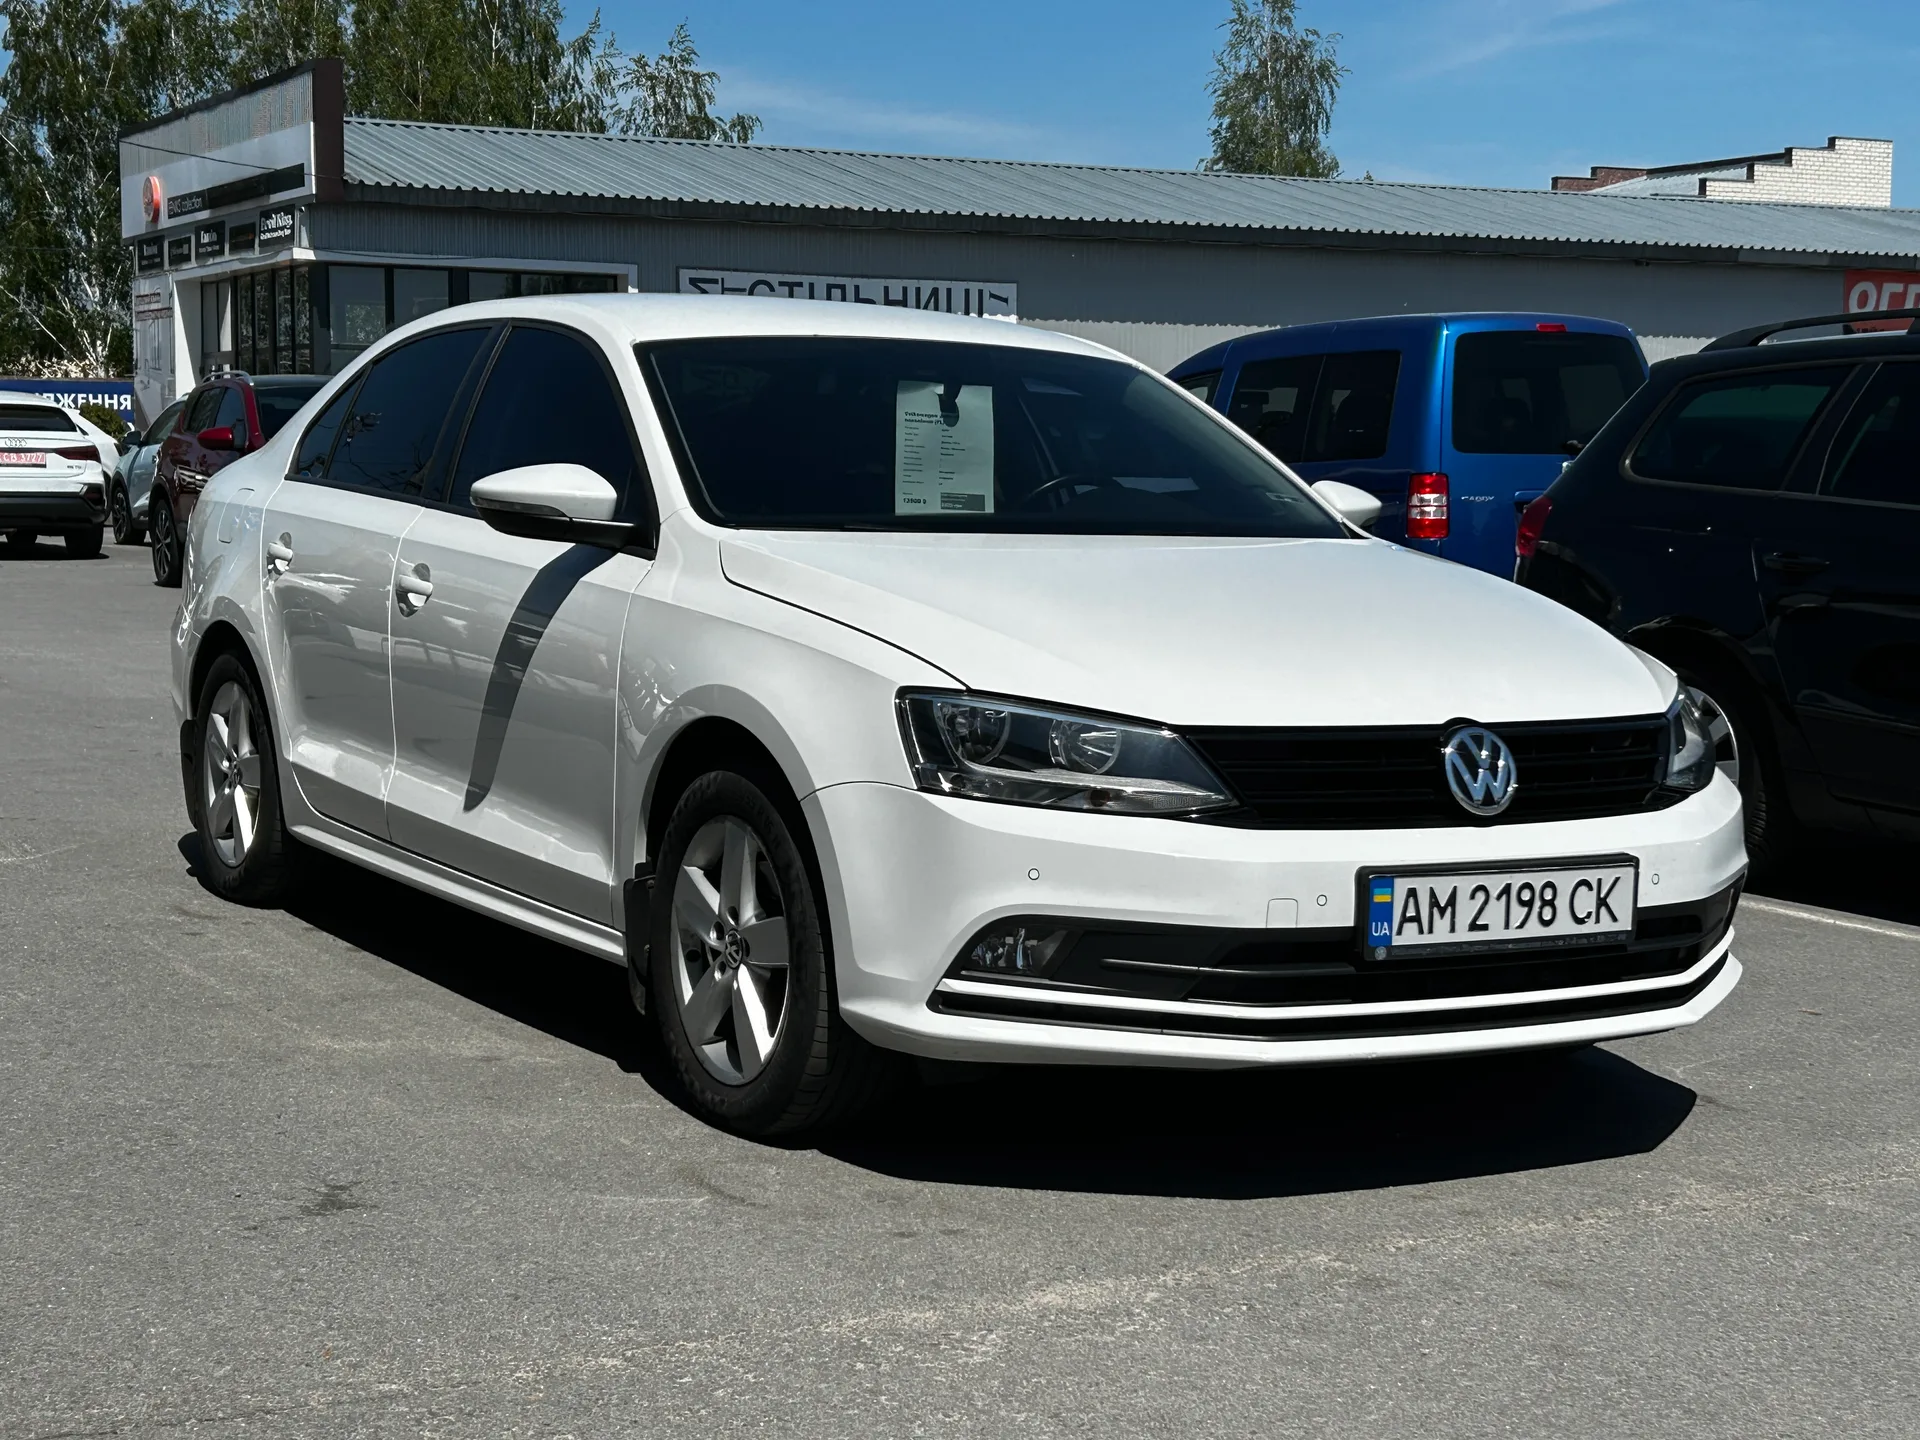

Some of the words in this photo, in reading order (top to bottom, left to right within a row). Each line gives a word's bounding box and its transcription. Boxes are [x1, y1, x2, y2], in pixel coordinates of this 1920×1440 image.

[1395, 885, 1458, 936] AM
[1467, 880, 1558, 932] 2198
[1568, 876, 1621, 926] CK
[1371, 921, 1390, 936] UA
